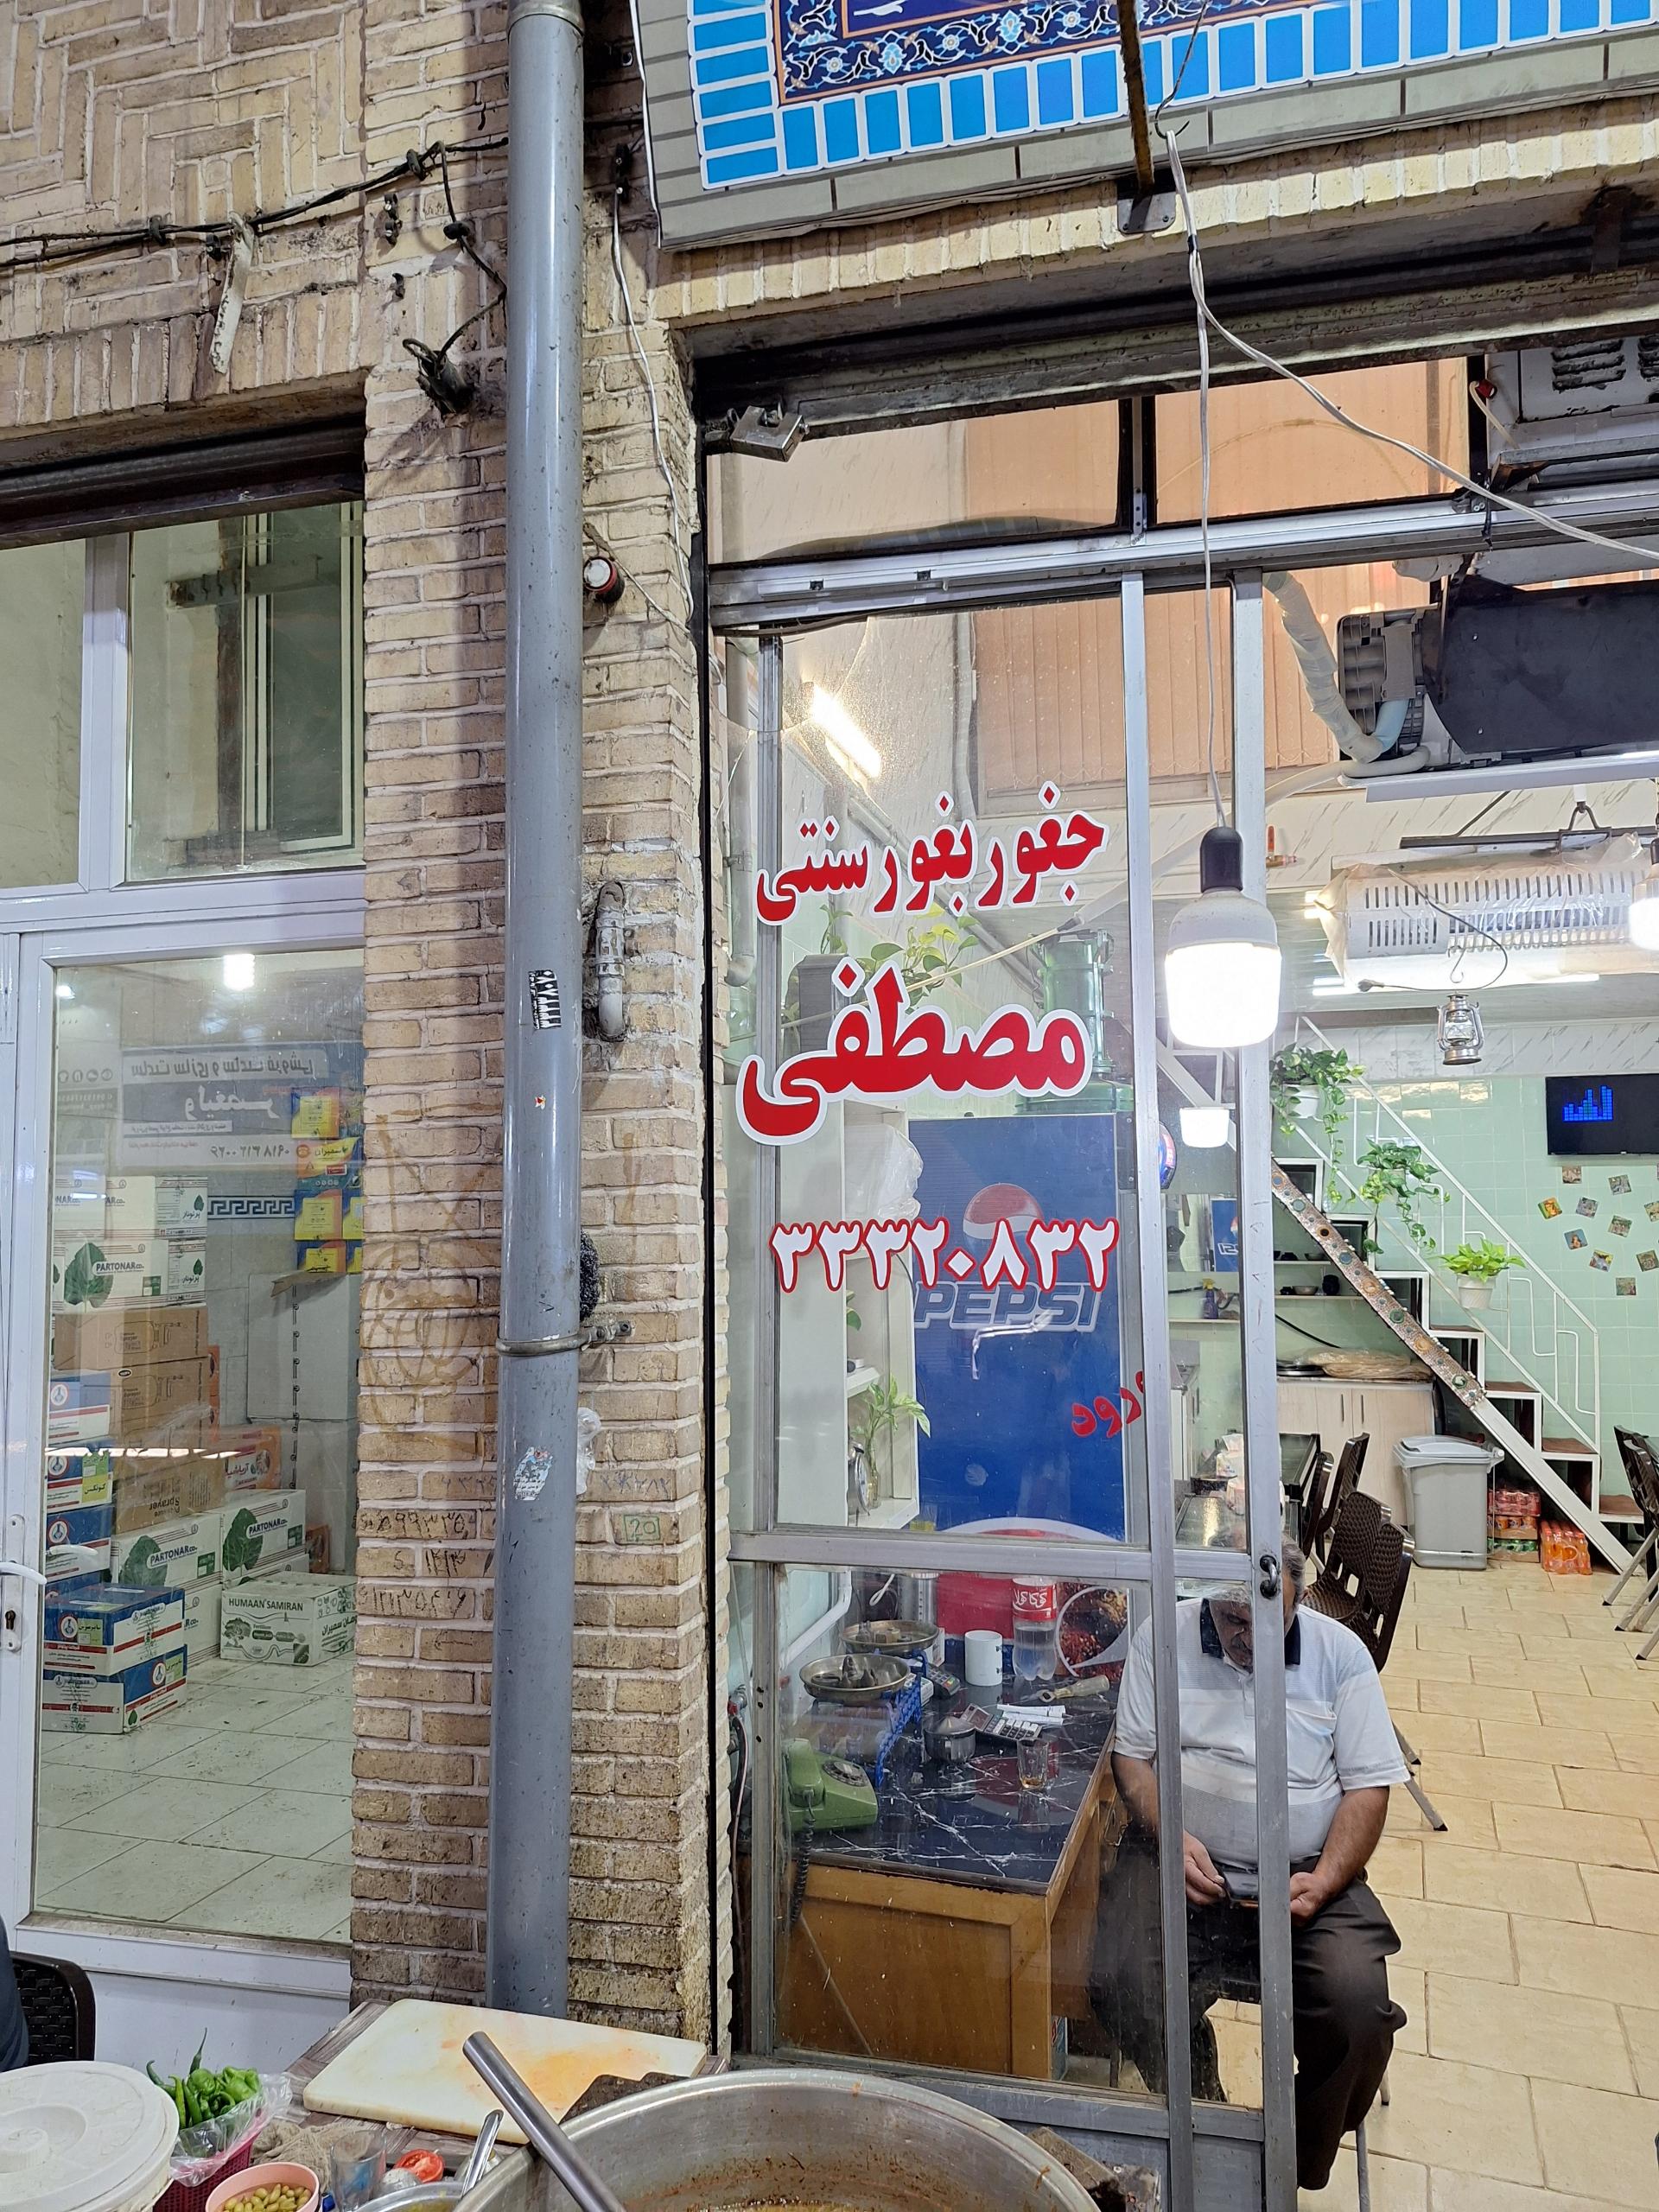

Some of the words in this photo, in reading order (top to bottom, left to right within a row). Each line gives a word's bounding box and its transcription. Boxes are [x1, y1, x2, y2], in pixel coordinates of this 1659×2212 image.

[755, 816, 871, 925] سنتی
[868, 791, 976, 918] بغور
[976, 780, 1109, 911] جغور
[736, 957, 1092, 1145] مصطفی
[96, 1262, 136, 1271] PARTONAR
[769, 1217, 1120, 1294] ۳۳۳۲۰۸۳۲
[913, 1281, 1102, 1332] PEPSI
[150, 1547, 189, 1564] PARTONAR
[249, 1517, 281, 1535] PARTONAR
[228, 1598, 266, 1609] HUMAAN
[266, 1600, 303, 1611] SAMIRAN
